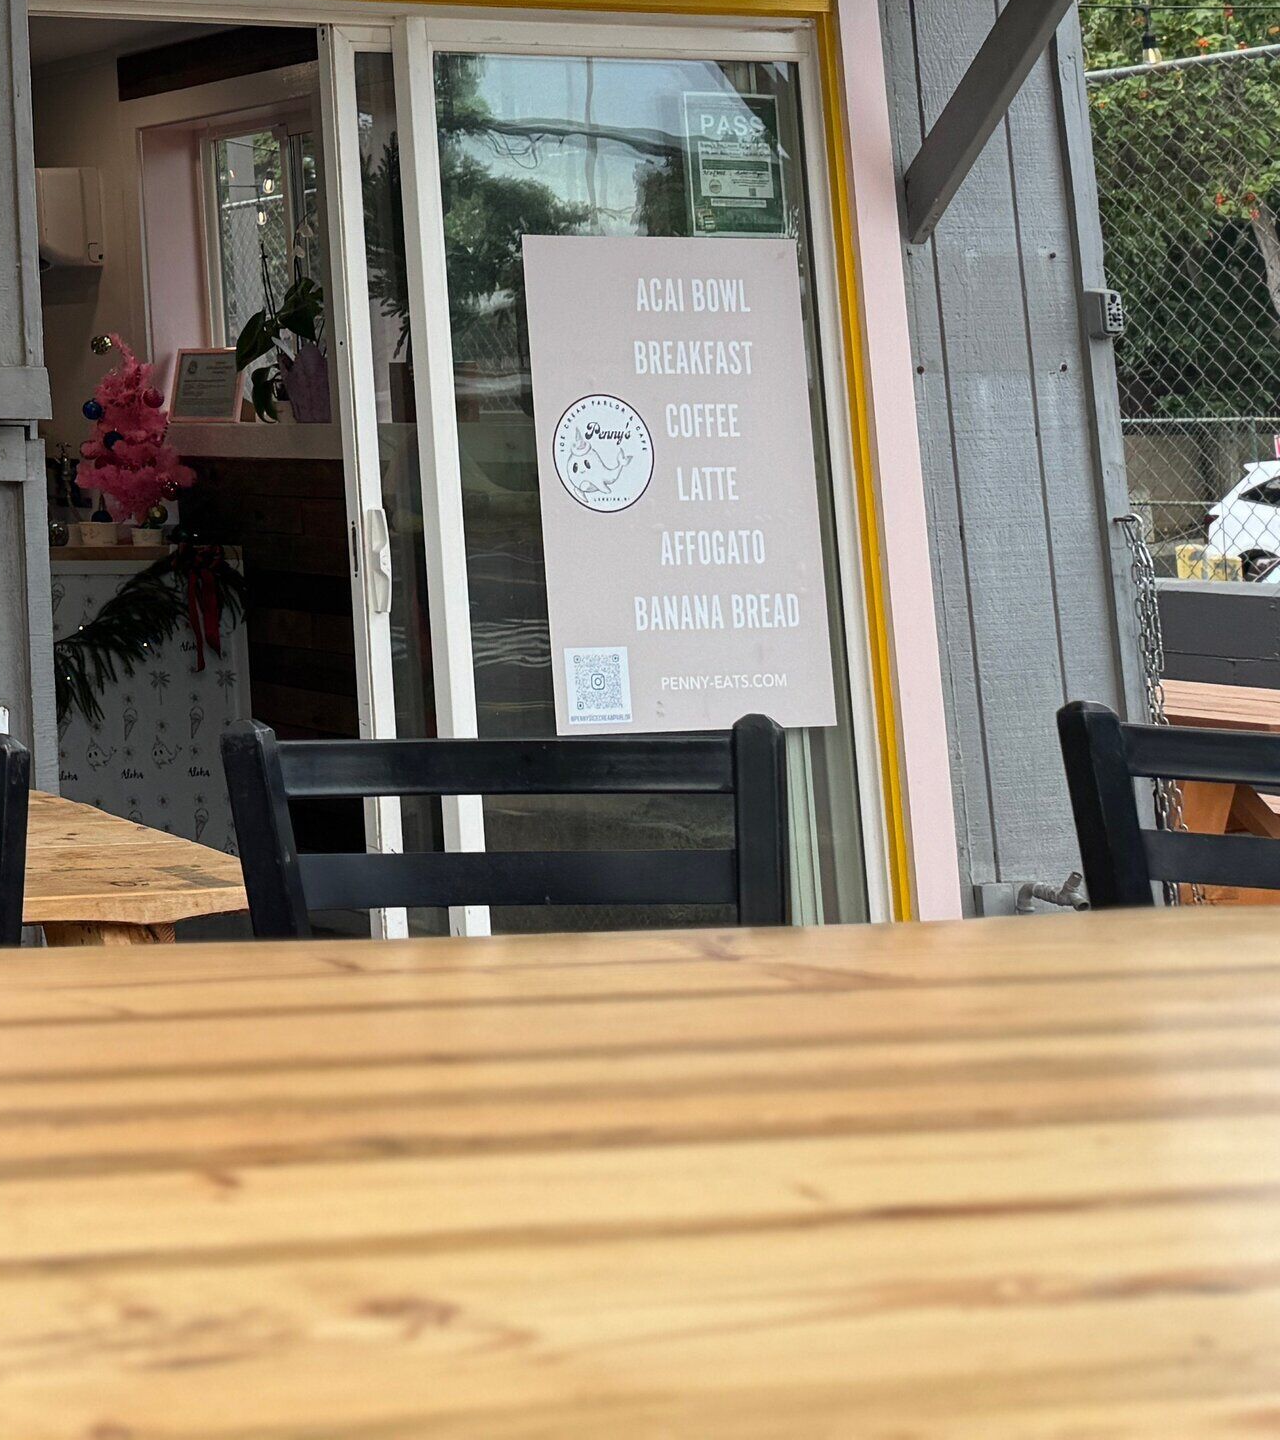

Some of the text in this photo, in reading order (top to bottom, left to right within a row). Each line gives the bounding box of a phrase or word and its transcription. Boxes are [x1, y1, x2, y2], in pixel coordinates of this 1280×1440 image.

[700, 114, 766, 137] PASS
[636, 277, 751, 312] ACAI BOWL
[633, 340, 753, 375] BREAKFAST
[585, 421, 631, 445] Penny's
[665, 403, 740, 438] COFFEE
[676, 466, 740, 501] LATTE
[661, 529, 766, 566] AFFOGATO
[634, 593, 800, 631] BANANA BREAD
[661, 673, 787, 691] PENNY-EATS.COM
[121, 769, 144, 780] Aloha
[188, 767, 210, 778] Aloha
